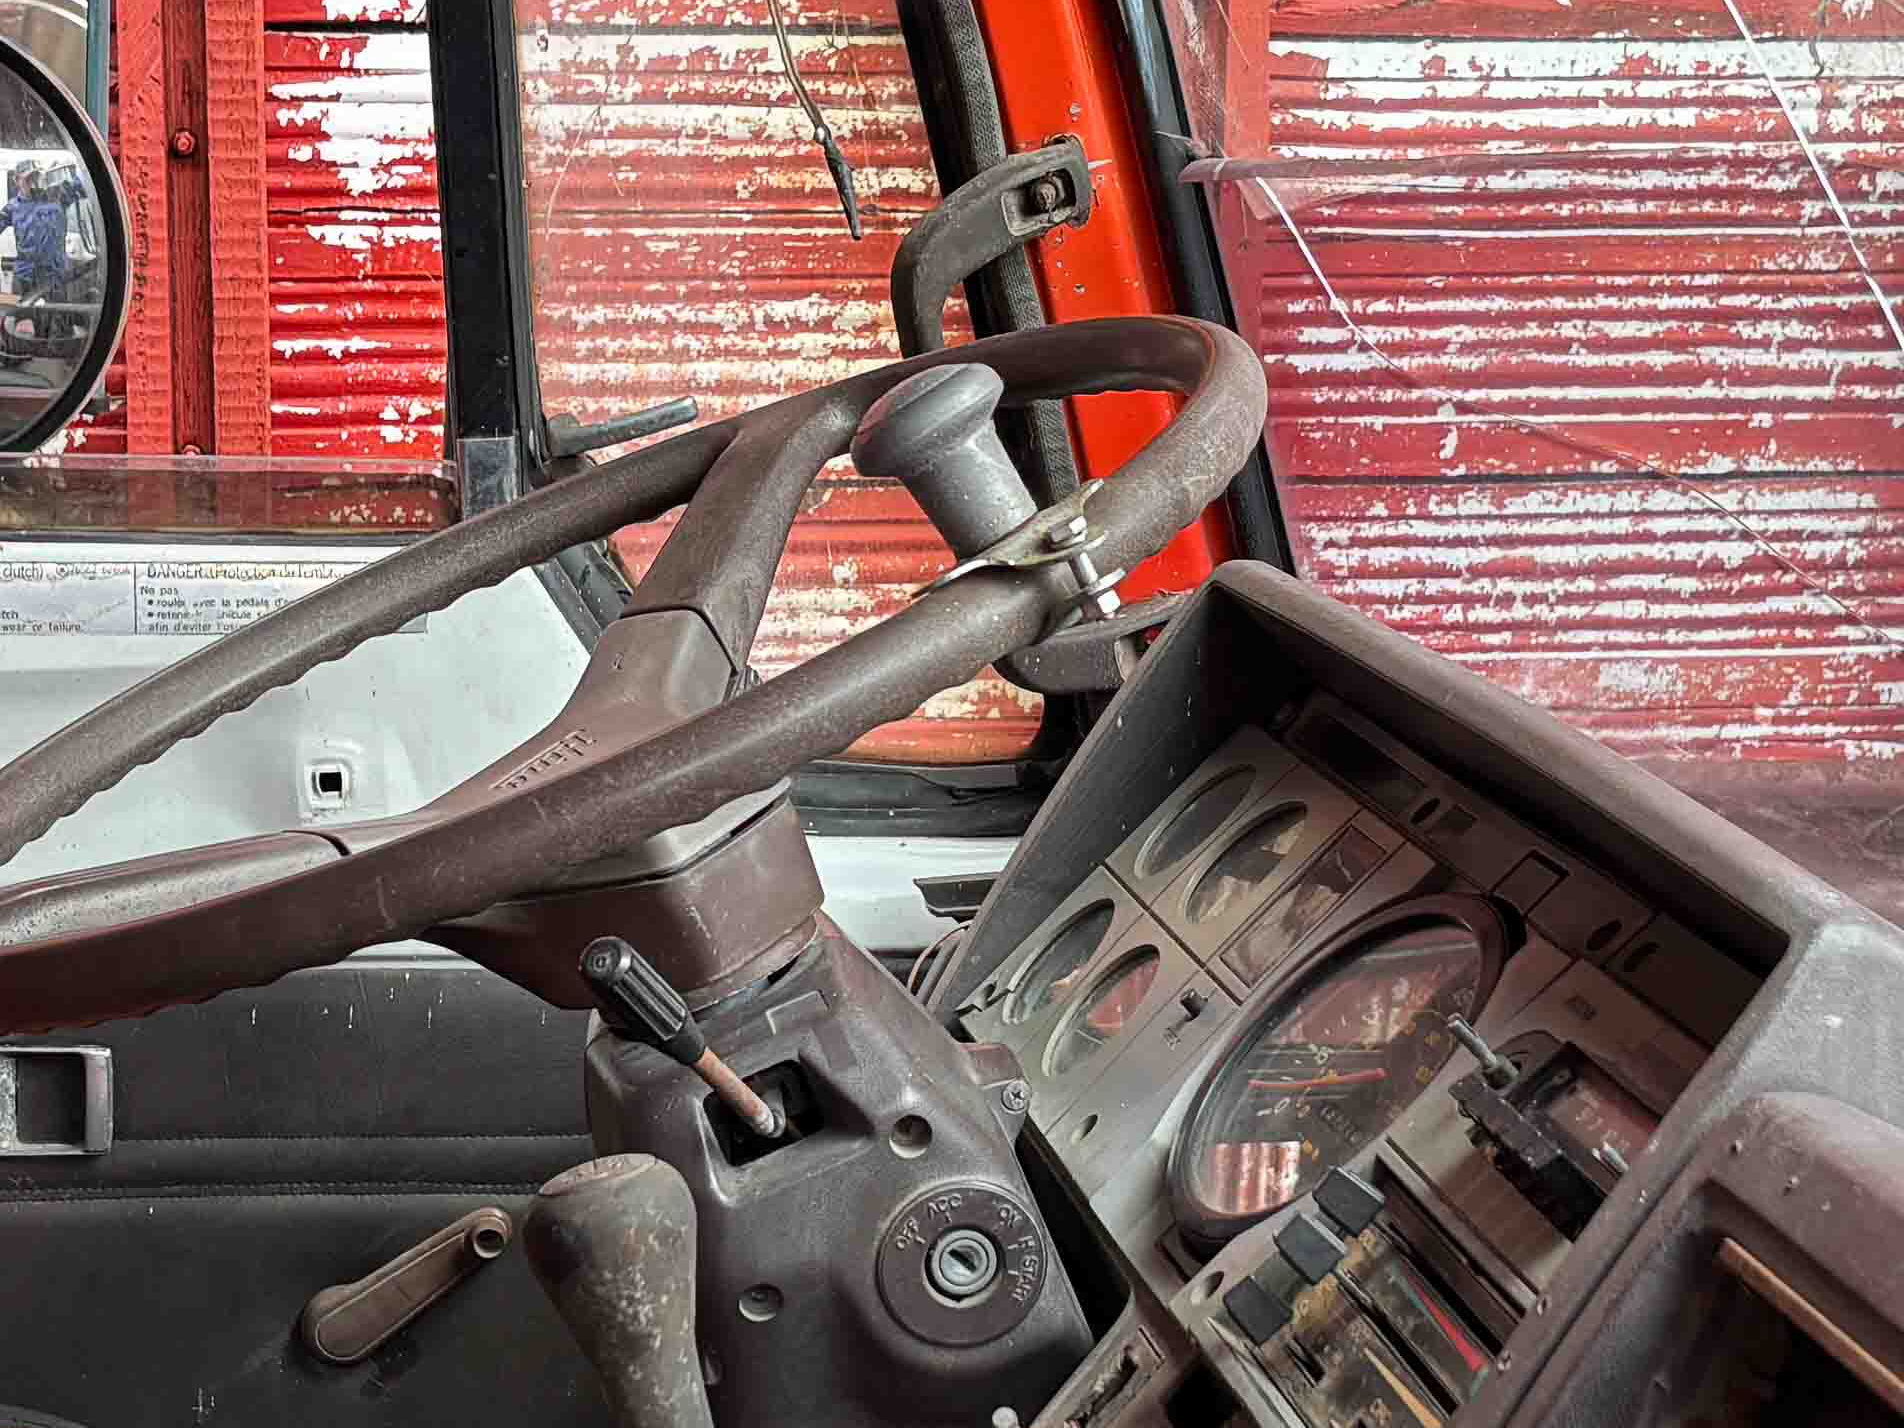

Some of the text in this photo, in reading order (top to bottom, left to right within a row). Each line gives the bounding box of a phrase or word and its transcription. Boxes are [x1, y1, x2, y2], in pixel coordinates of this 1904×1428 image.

[140, 585, 179, 597] Ne pas
[1, 623, 27, 632] wear
[148, 621, 169, 632] afin
[928, 1192, 963, 1221] ACC
[895, 1216, 921, 1251] OFF
[1012, 1253, 1041, 1307] START
